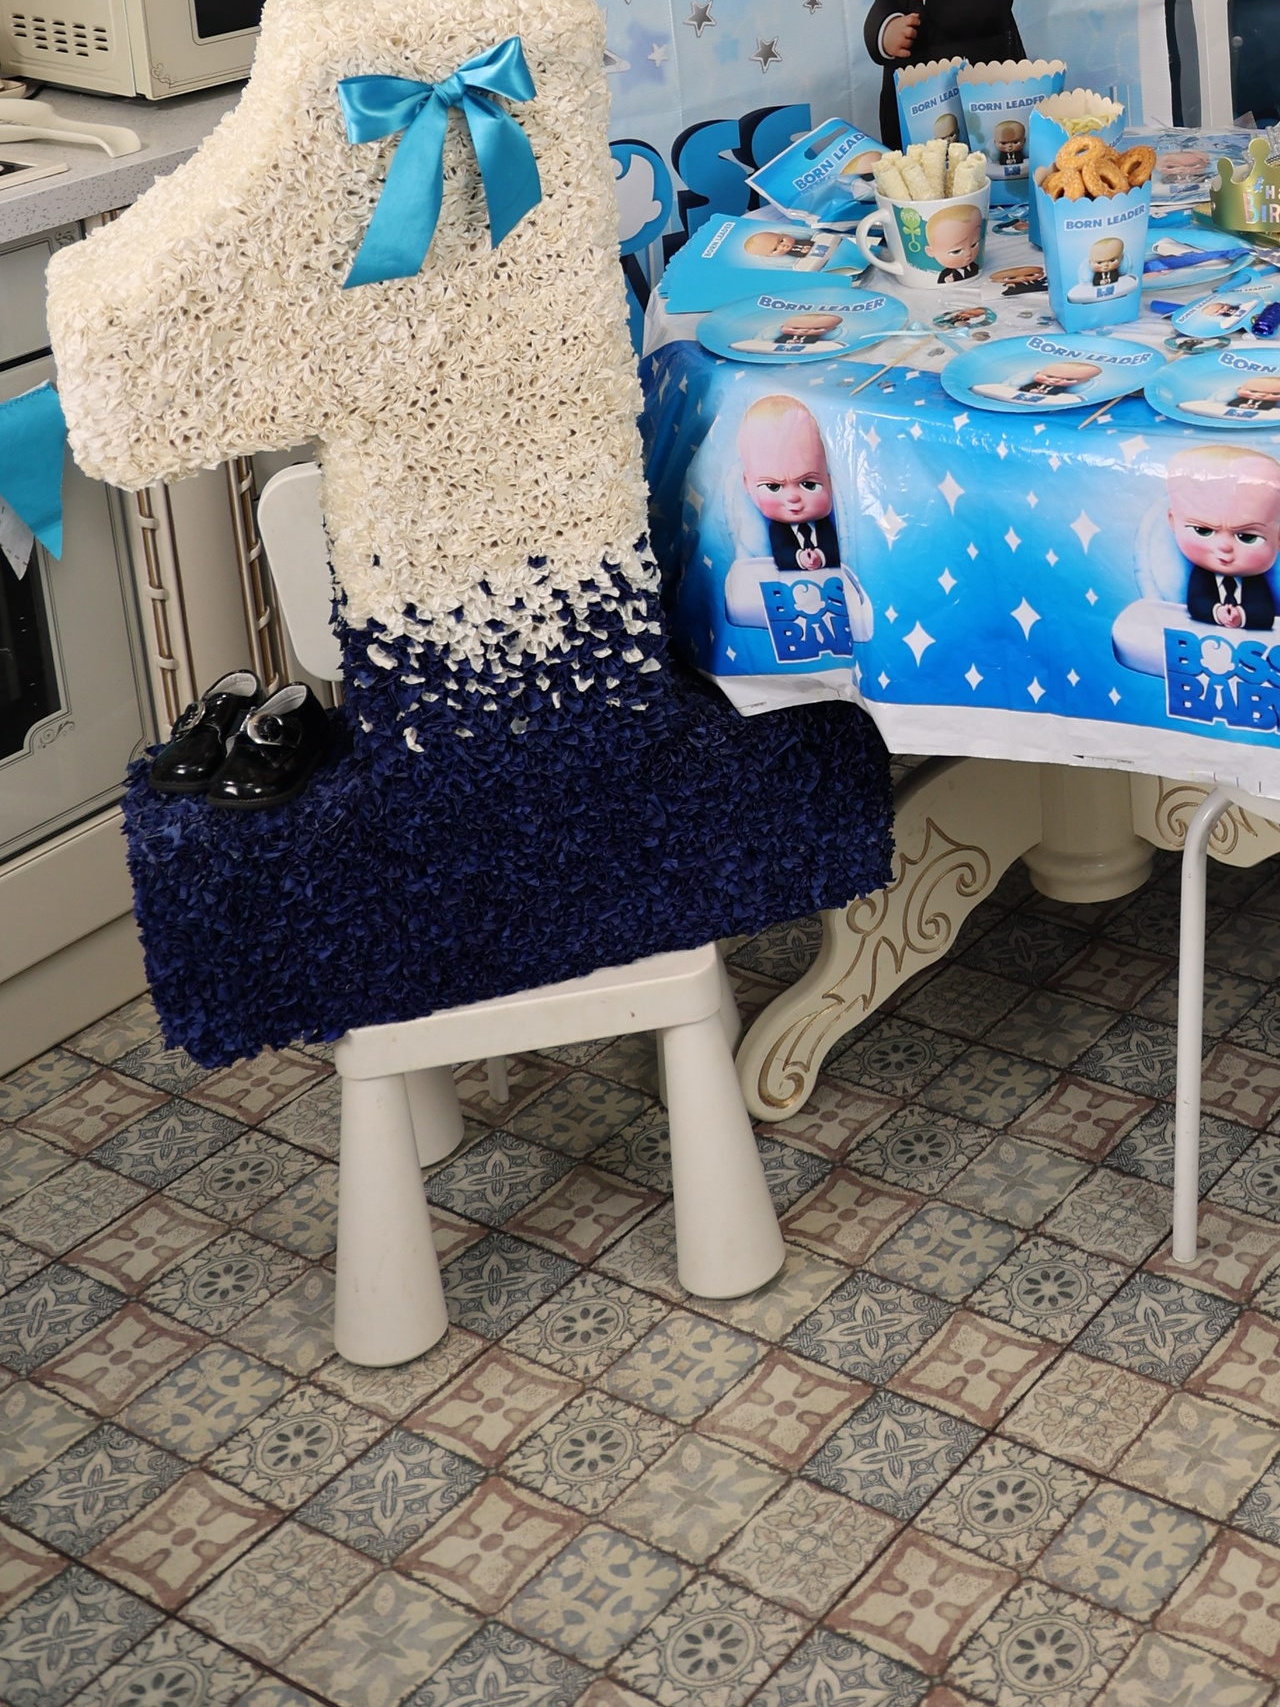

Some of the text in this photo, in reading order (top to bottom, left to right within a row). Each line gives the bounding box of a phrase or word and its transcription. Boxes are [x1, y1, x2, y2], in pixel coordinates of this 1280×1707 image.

[910, 87, 959, 116] BORN LEAD
[970, 94, 1046, 113] BORN LEADER
[793, 131, 871, 191] BORN LEAD
[1065, 204, 1146, 230] BORN LEADER
[703, 222, 736, 258] BORN LEADER
[760, 295, 886, 312] BORN LEADER
[1027, 336, 1152, 366] BORN LEADER
[1219, 351, 1279, 374] BORN
[759, 577, 850, 622] BOS
[769, 614, 854, 662] BAB
